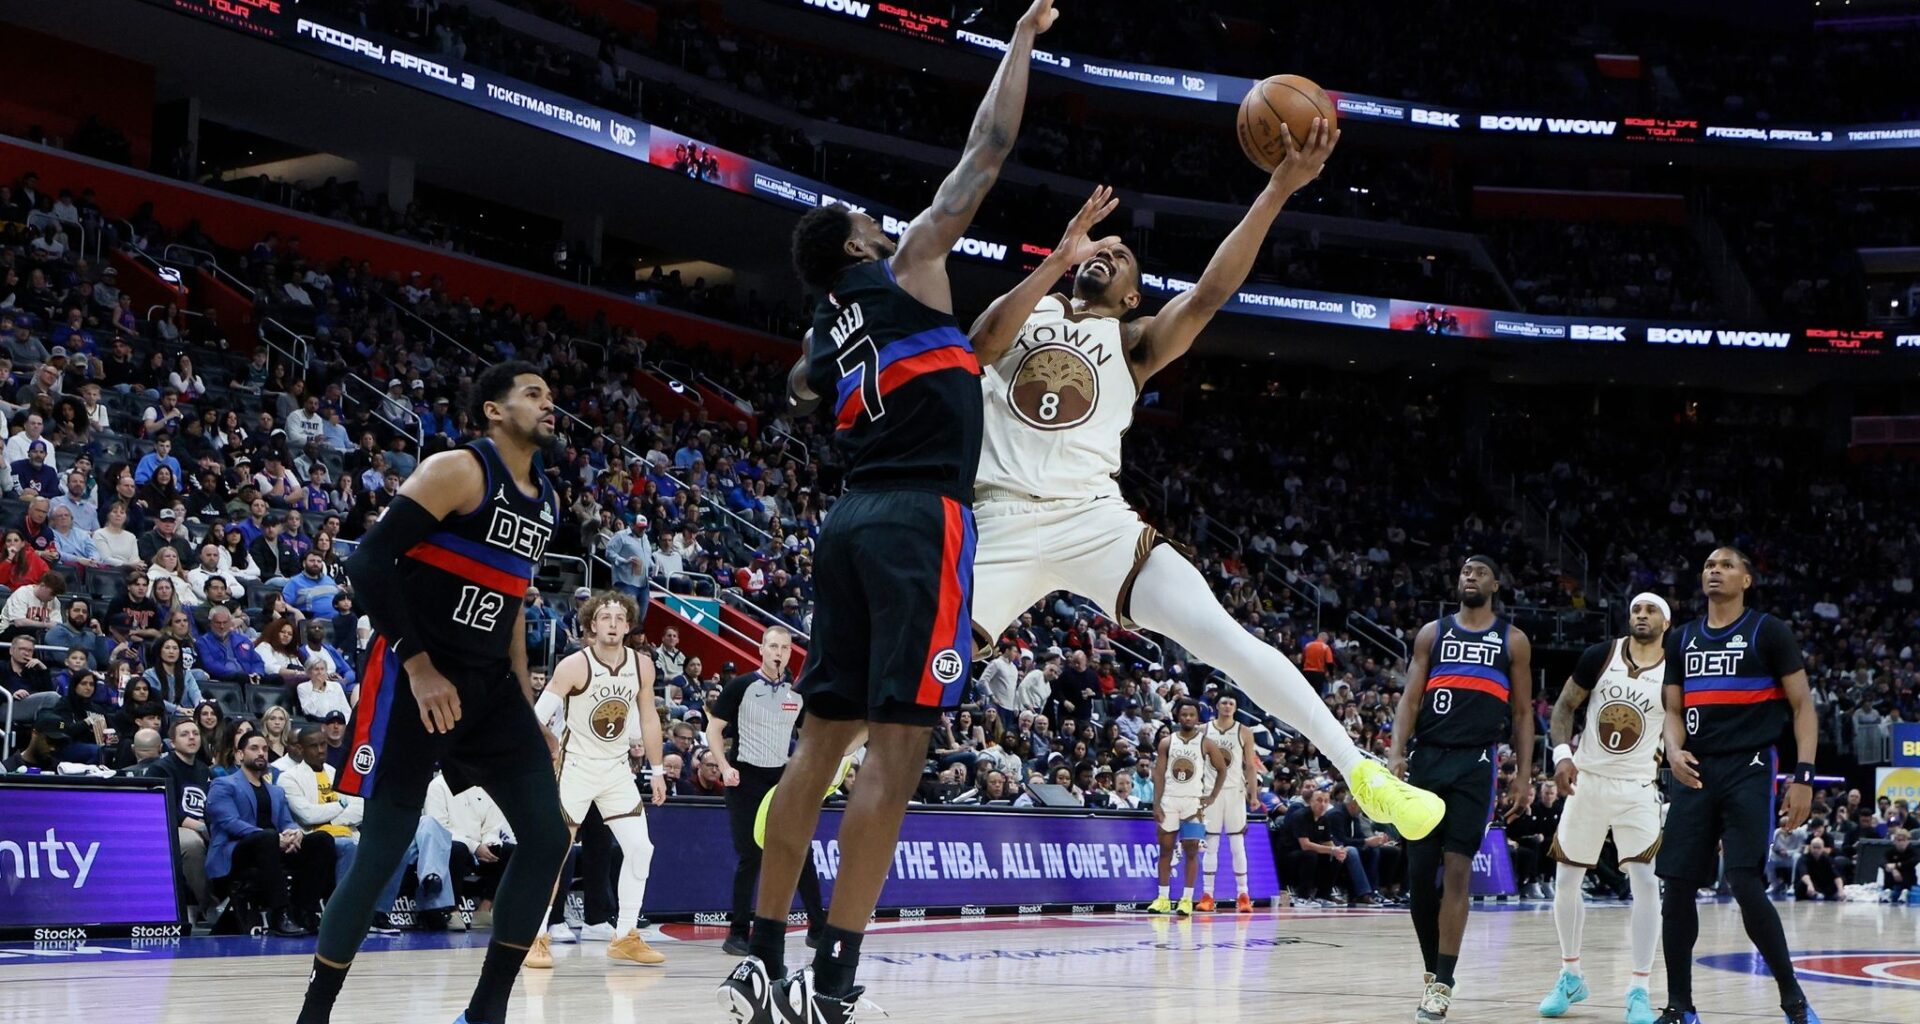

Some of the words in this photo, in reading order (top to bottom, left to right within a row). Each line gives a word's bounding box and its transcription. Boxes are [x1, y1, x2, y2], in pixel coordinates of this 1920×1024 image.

[899, 18, 928, 33] TOUR
[297, 18, 386, 64] FRIDAY,
[390, 49, 457, 84] APRIL
[461, 73, 475, 91] 3
[956, 30, 1011, 53] FRIDAY
[1031, 49, 1059, 65] RIL
[1060, 57, 1071, 68] 3
[1083, 63, 1175, 86] TICKETMASTER.COM
[487, 83, 602, 133] TICKETMASTER.COM
[1411, 108, 1460, 128] B2K
[1480, 115, 1542, 132] BOW
[1546, 118, 1617, 135] WOW
[1706, 127, 1767, 141] FRIDAY,
[1769, 130, 1819, 142] APRIL
[1821, 131, 1832, 142] 3
[1848, 129, 1920, 141] TICKETMASTER
[1239, 292, 1344, 313] TICKETMASTER.COM
[829, 302, 864, 349] REED
[1570, 325, 1626, 341] B2K
[1014, 325, 1112, 367] TOWN
[1647, 328, 1712, 344] BOW
[1717, 330, 1791, 348] WOW
[836, 335, 886, 422] 7
[1039, 392, 1060, 420] 8
[485, 506, 552, 562] DET
[452, 585, 504, 632] 12
[1440, 640, 1501, 666] DET
[938, 658, 958, 674] DET
[1685, 650, 1744, 678] DET
[590, 684, 635, 703] TOWN
[1433, 688, 1452, 714] 8
[1600, 685, 1655, 714] TOWN
[606, 722, 615, 737] 2
[1686, 707, 1699, 735] 9
[1609, 731, 1622, 749] 0
[357, 752, 372, 767] DET
[1887, 785, 1920, 798] HIG
[0, 828, 100, 888] nity
[894, 841, 937, 879] THE
[941, 841, 999, 880] NBA.
[1001, 843, 1042, 879] ALL
[1042, 843, 1067, 879] IN
[1068, 843, 1110, 879] ONE
[694, 912, 727, 922] StockX
[787, 911, 808, 921] ockX
[899, 908, 926, 918] StockX
[961, 906, 986, 916] StockX
[1018, 905, 1042, 914] StockX
[1072, 904, 1095, 914] StockX
[34, 928, 87, 940] StockX
[131, 925, 182, 937] StockX
